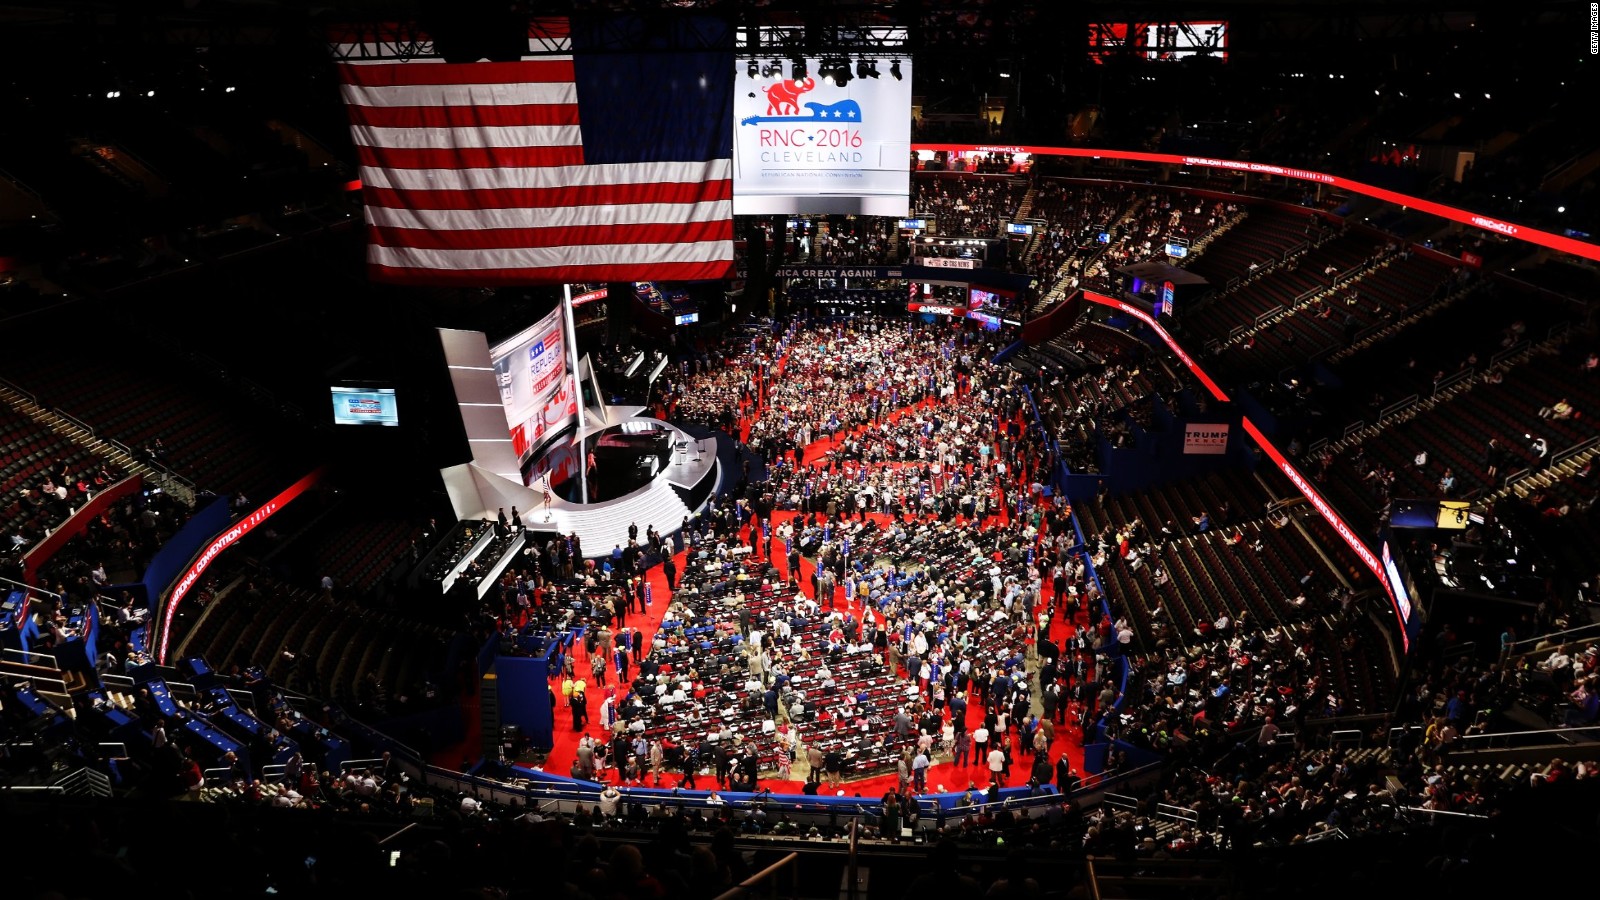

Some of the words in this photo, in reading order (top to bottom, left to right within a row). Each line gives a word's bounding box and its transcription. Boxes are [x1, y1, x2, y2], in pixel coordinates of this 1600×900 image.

[760, 129, 806, 147] RNC
[816, 129, 863, 147] 2016
[761, 151, 863, 162] CLEVELAND
[1222, 161, 1250, 169] NATIONAL
[927, 305, 955, 315] MSNBC
[1285, 464, 1314, 500] REPUBLICAN
[1313, 495, 1338, 528] NATIONAL
[1339, 523, 1378, 570] CONVENTION
[171, 569, 197, 609] NATIONAL
[196, 526, 242, 573] CONVENTION
